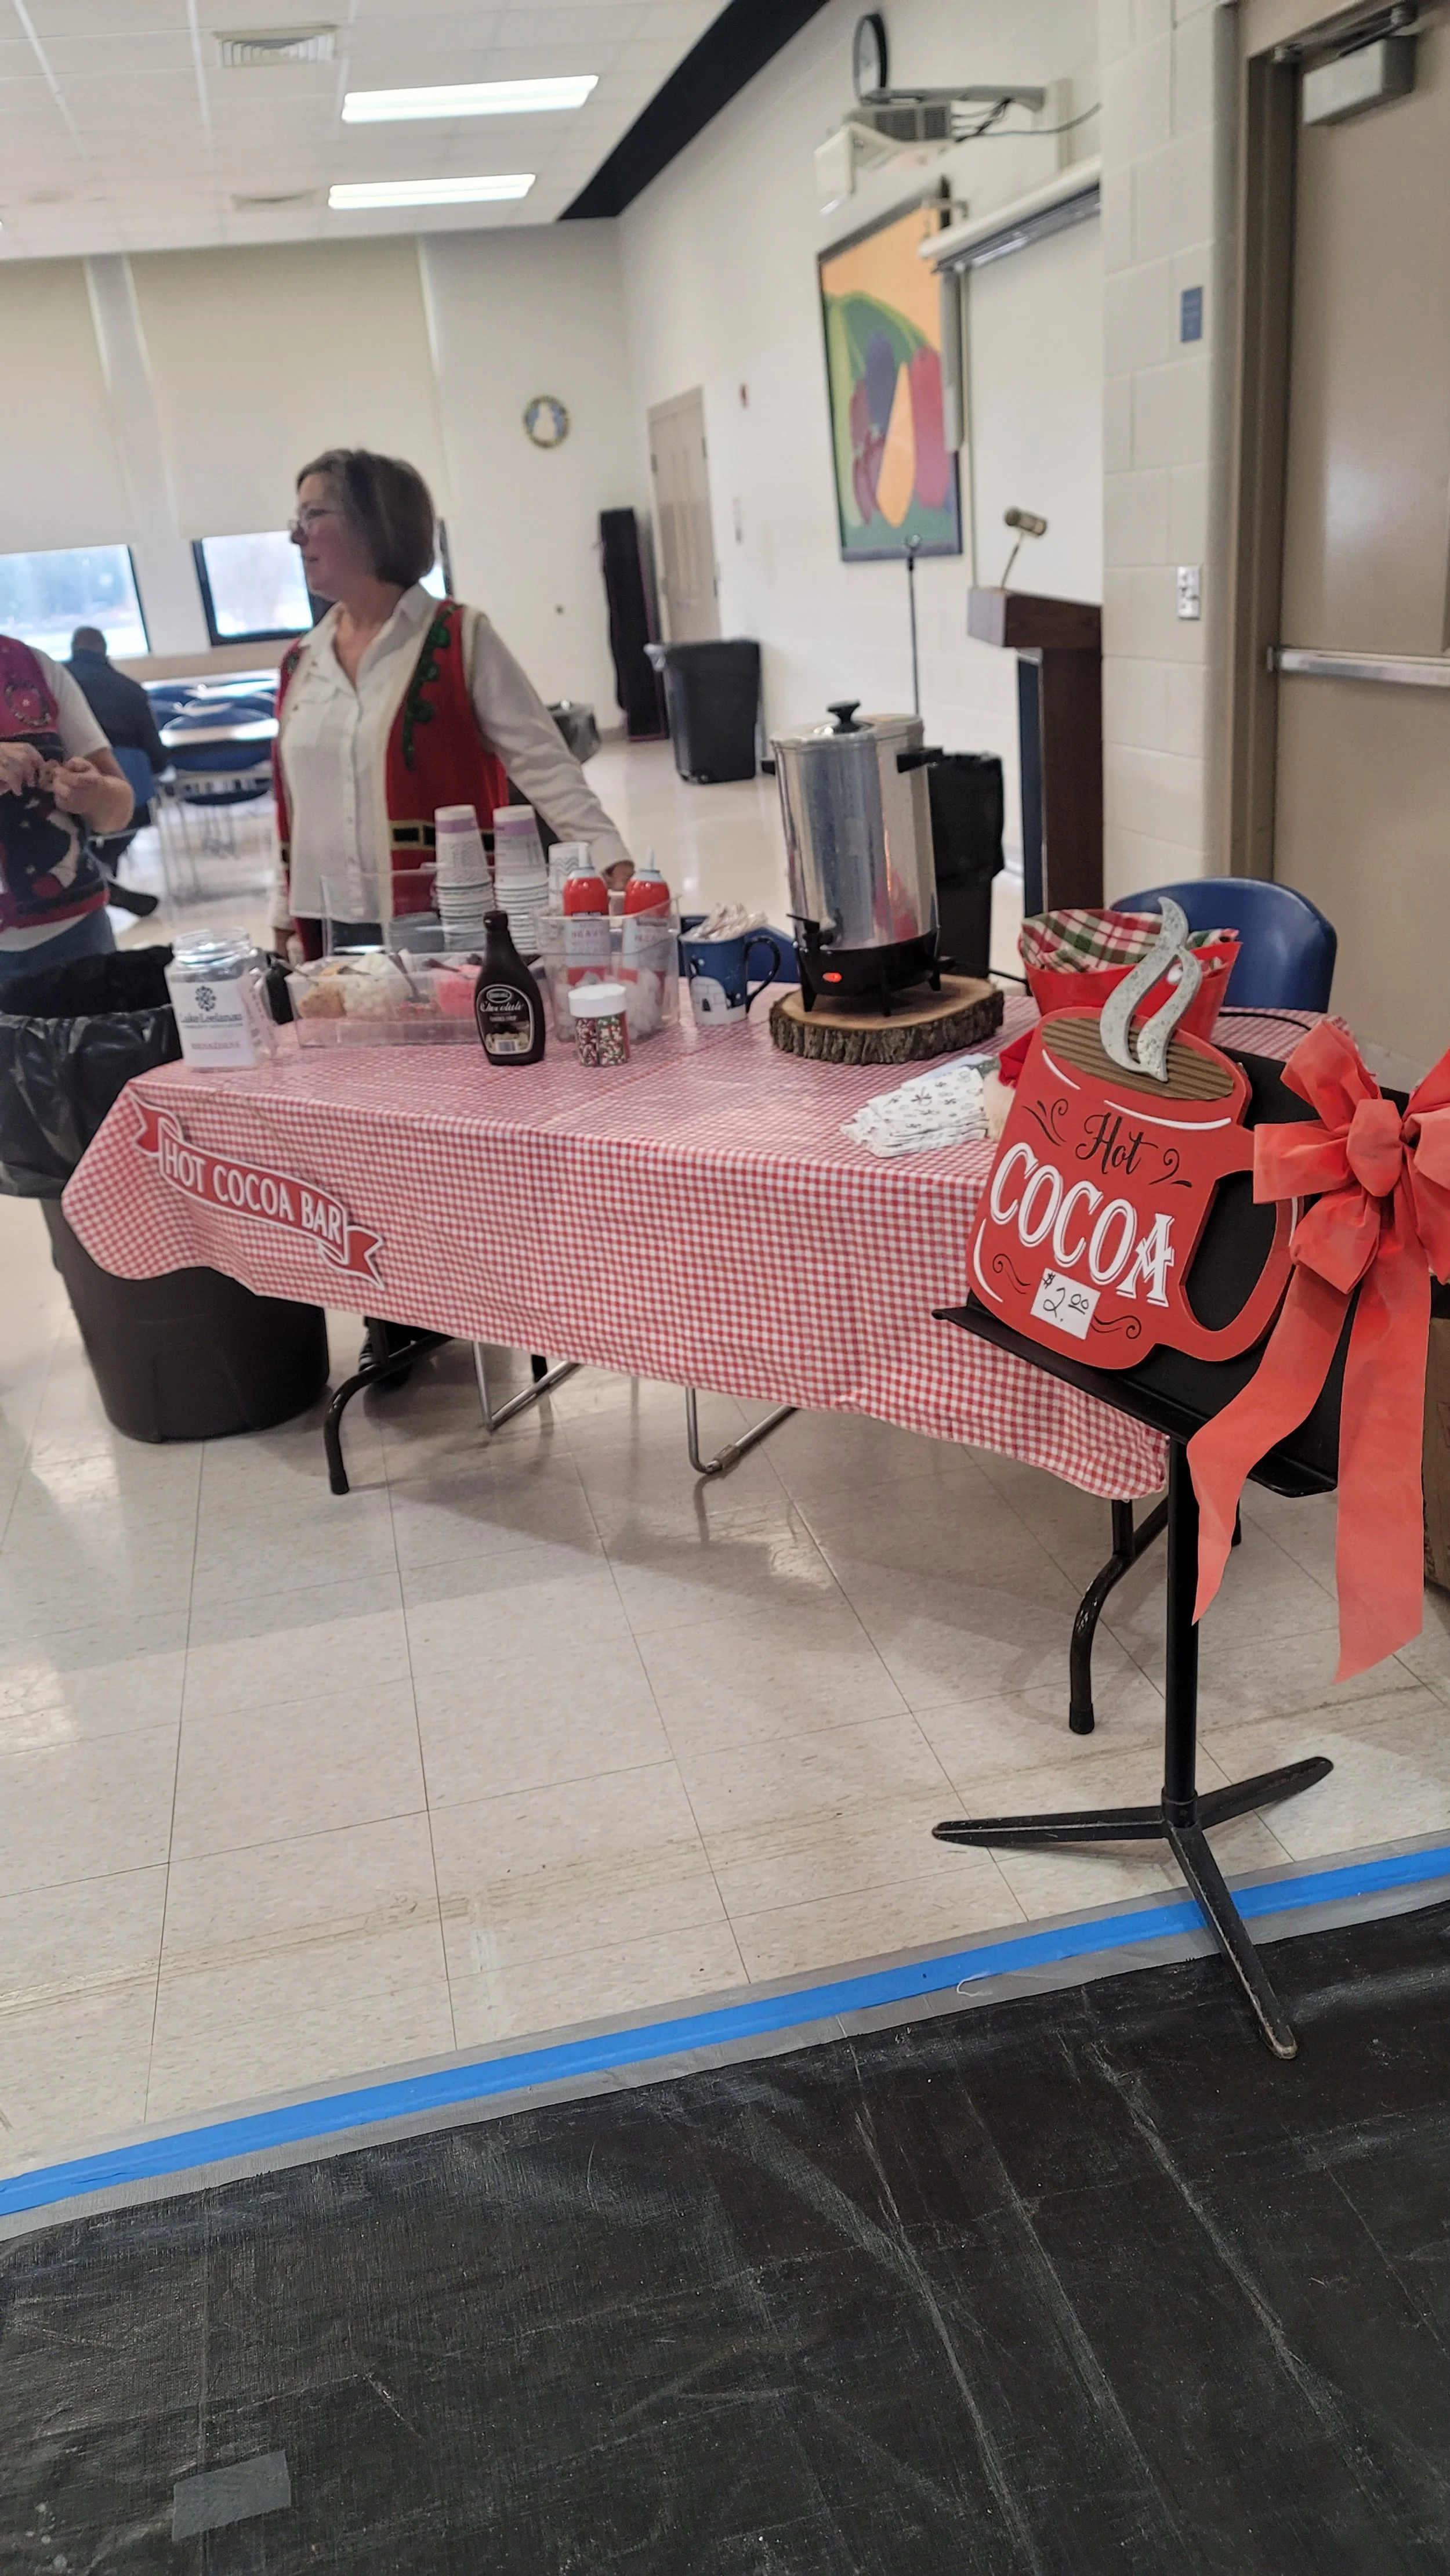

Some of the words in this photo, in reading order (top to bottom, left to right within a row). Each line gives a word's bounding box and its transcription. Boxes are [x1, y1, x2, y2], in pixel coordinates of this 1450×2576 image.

[164, 1139, 206, 1193] HOT
[213, 1164, 294, 1221] COCOA
[300, 1190, 342, 1244] BAR
[1075, 1112, 1159, 1174] Hot
[989, 1142, 1175, 1308] COCOA
